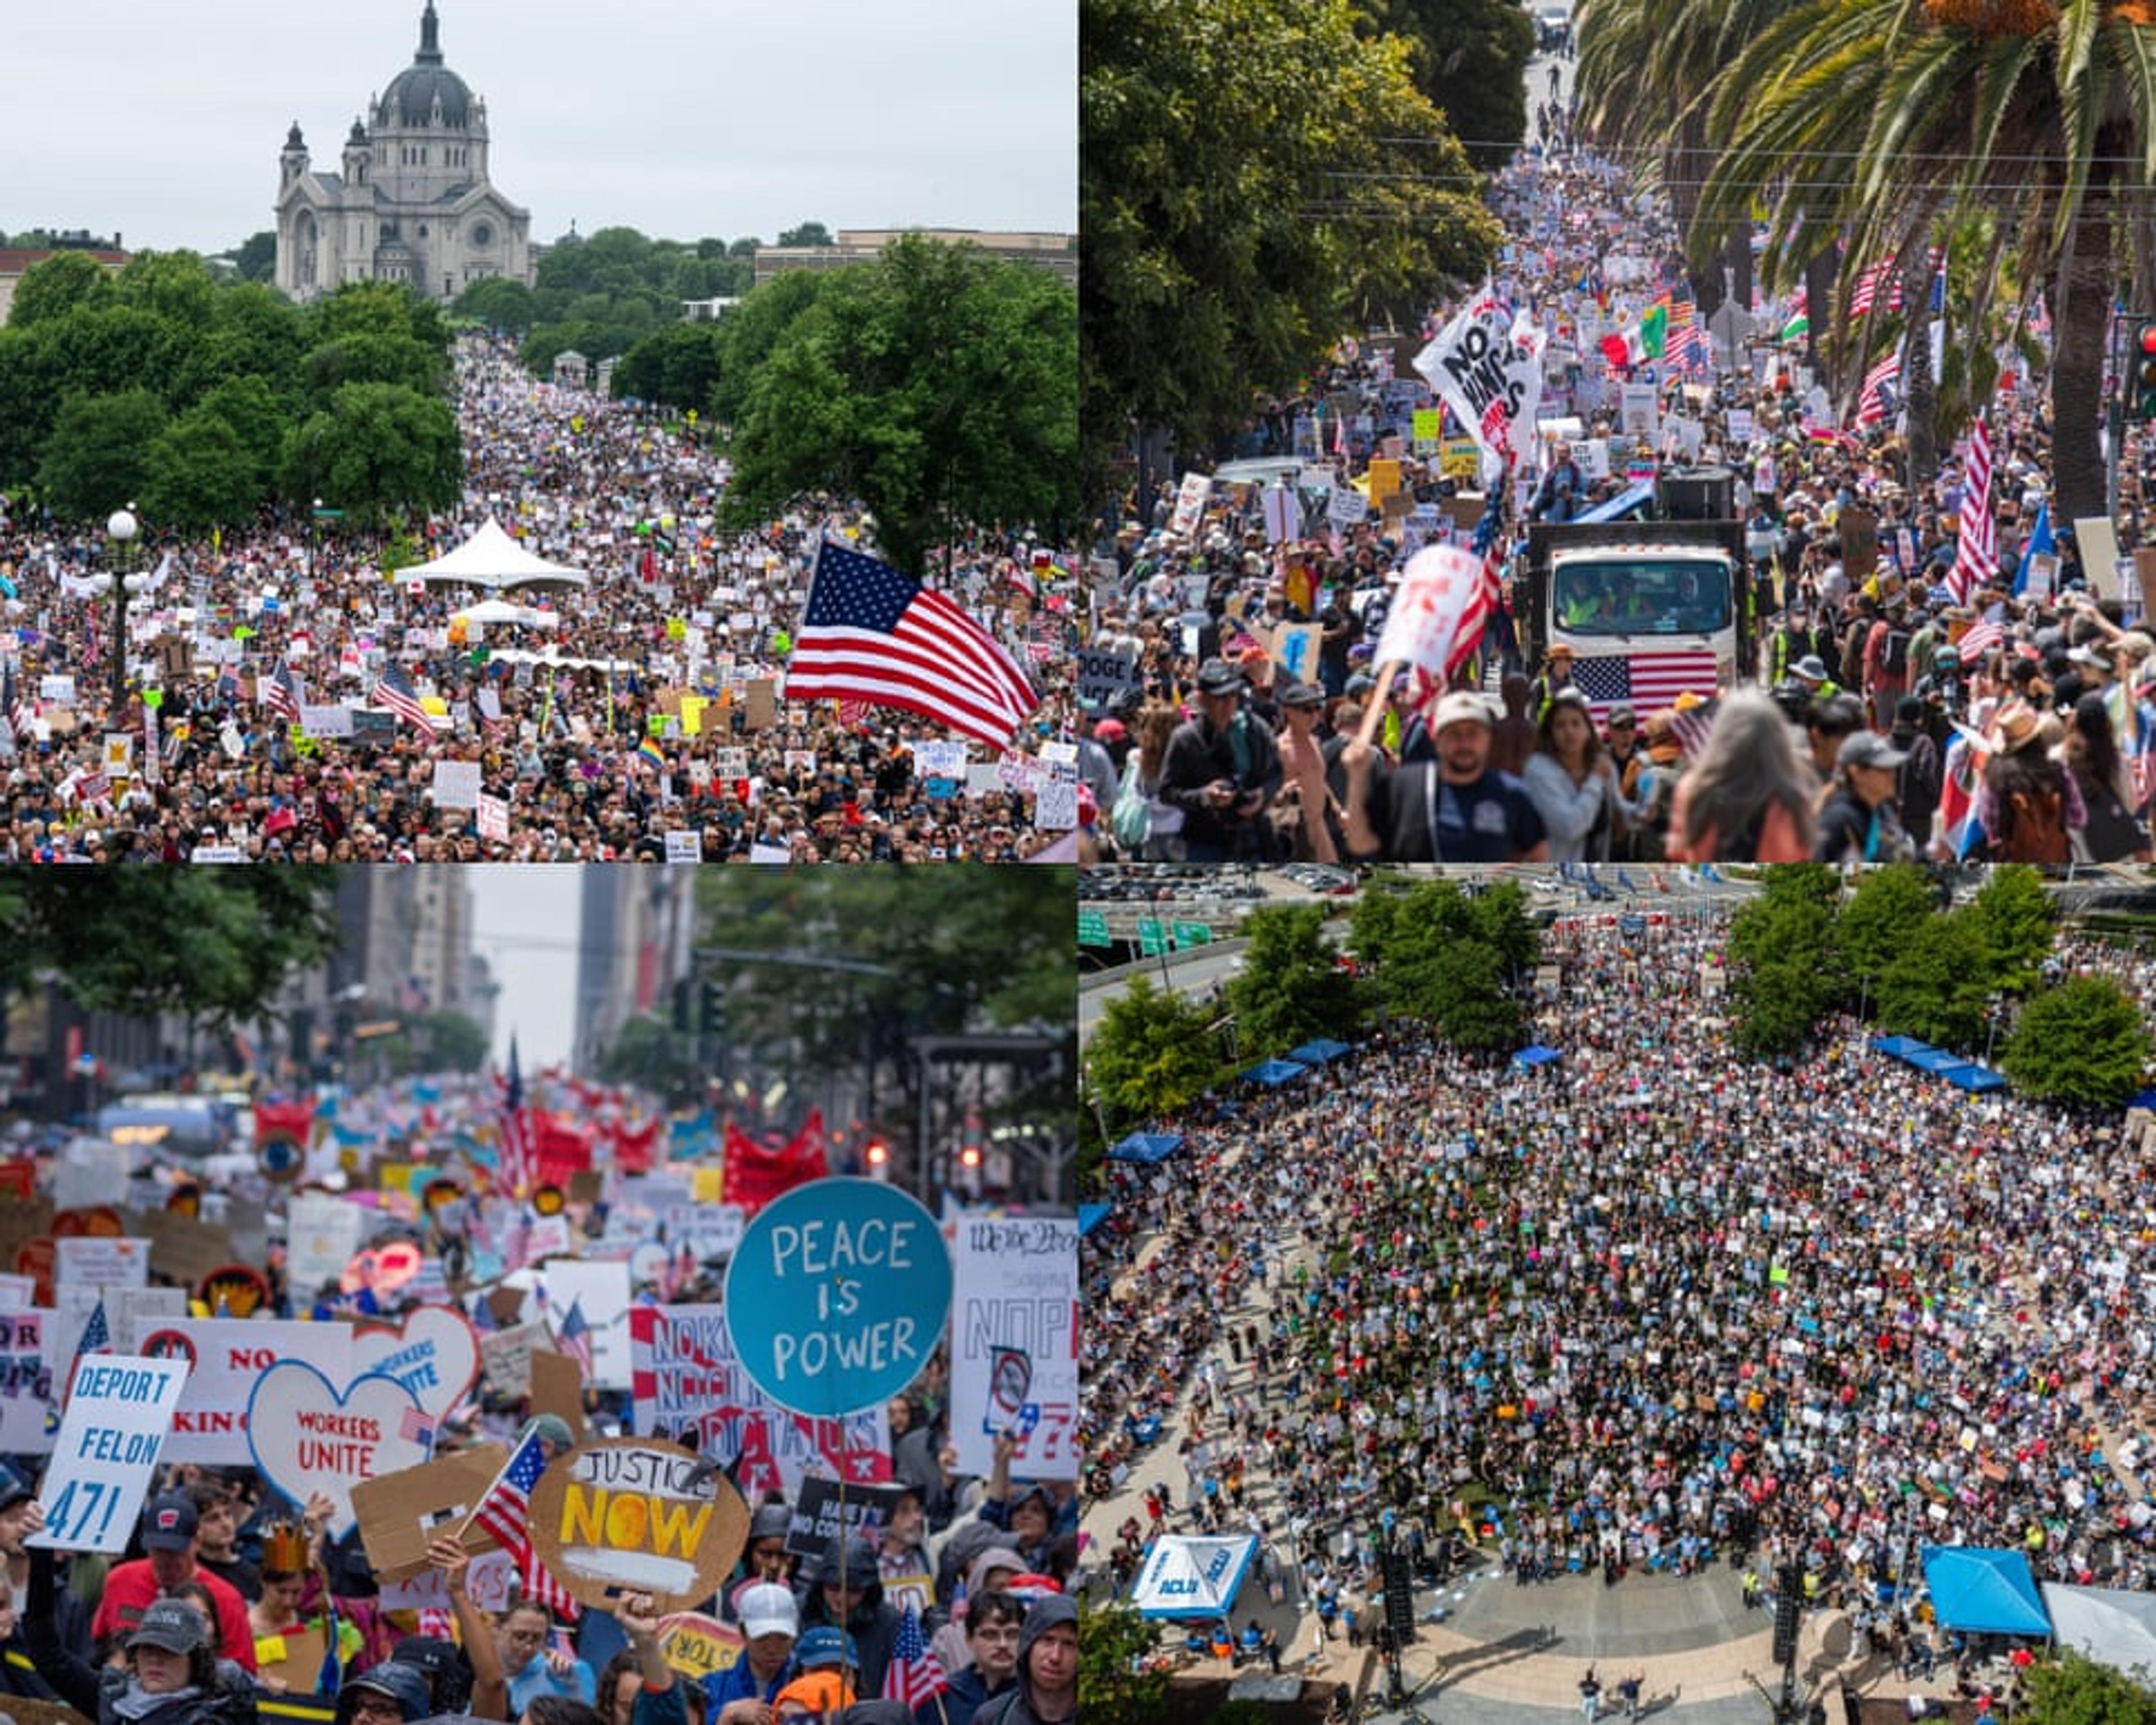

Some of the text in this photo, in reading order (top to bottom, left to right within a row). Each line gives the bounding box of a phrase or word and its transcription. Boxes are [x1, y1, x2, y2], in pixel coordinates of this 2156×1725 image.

[1441, 326, 1487, 386] NO
[771, 1218, 916, 1277] PEACE
[817, 1279, 862, 1322] IS
[773, 1315, 917, 1381] POWER
[965, 1298, 1078, 1359] NOP
[229, 1349, 277, 1370] NO
[75, 1366, 171, 1404] DEPORT
[77, 1427, 161, 1466] FELON
[296, 1408, 381, 1443] WORKERS
[298, 1439, 376, 1479] UNITE
[581, 1450, 713, 1499] JUSTICE
[44, 1478, 122, 1546] 47!
[558, 1481, 714, 1560] NOW
